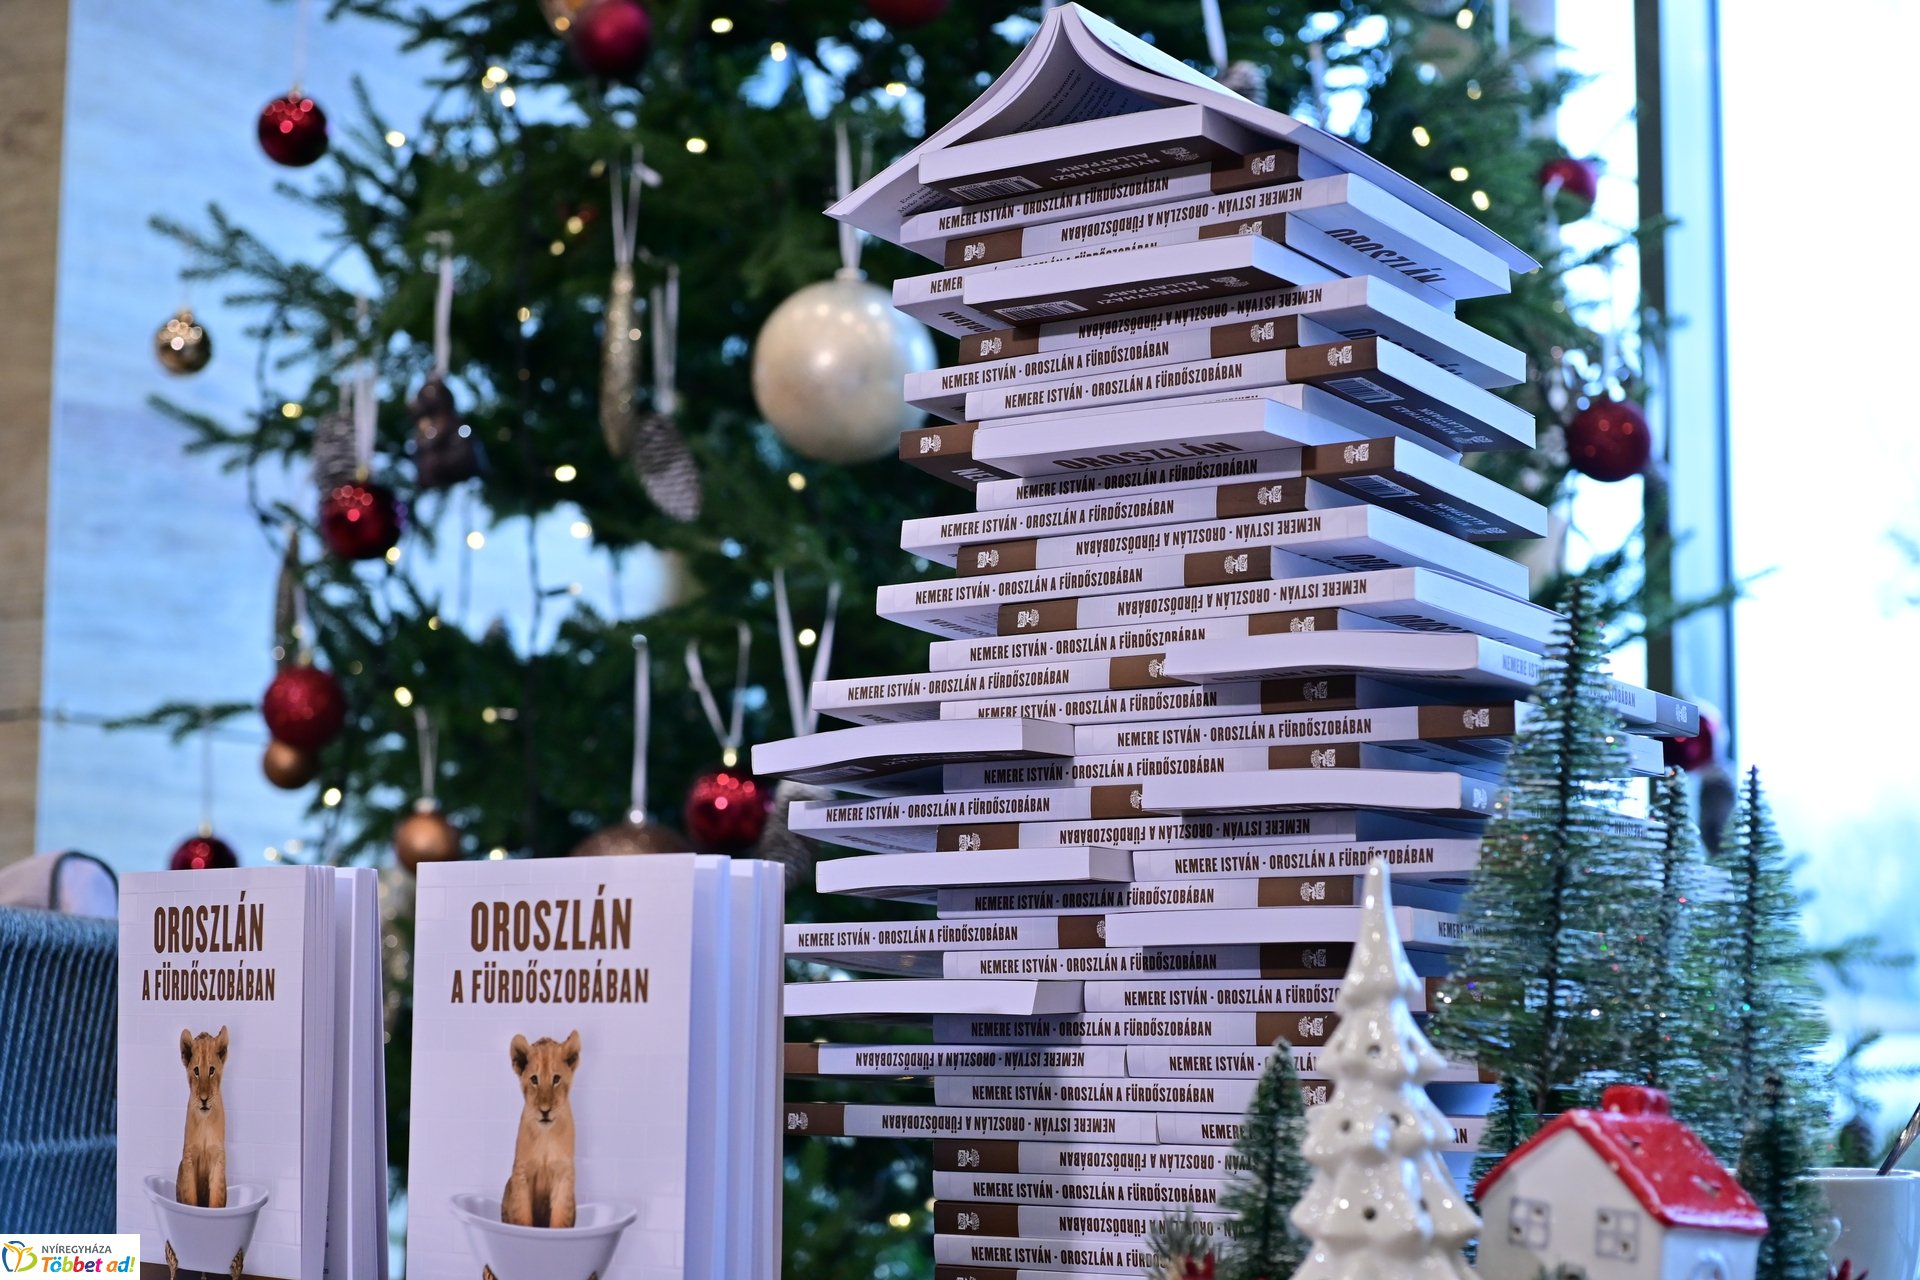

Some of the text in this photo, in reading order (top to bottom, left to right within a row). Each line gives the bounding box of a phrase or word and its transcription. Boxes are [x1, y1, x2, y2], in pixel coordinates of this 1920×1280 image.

[938, 176, 1168, 230] NEMERE ISTVÁN OROSZLÁN A FÜRDŐSZOBÁBAN
[1061, 186, 1302, 242] NEMERE ISTVÁN OROSZLÁN A FÜRDŐSZOBÁBAN
[1078, 288, 1321, 339] NEMERE ISTVÁN OROSZLÁN A FÜRDŐSZOBÁBAN
[942, 340, 1168, 390] NEMERE ISTVÁN OROSZLÁN A FÜRDŐSZOBÁBAN
[1004, 362, 1241, 409] NEMERE ISTVÁN OROSZLÁN A FÜRDŐSZOBÁBAN
[1053, 442, 1245, 470] OROSZLÁN
[1016, 457, 1257, 500] NEMERE ISTVÁN OROSZLÁN A FÜRDŐSZOBÁBAN
[940, 498, 1173, 538] NEMERE ISTVÁN OROSZLÁN A FÜRDŐSZOBÁBAN
[1076, 516, 1320, 557] NEMERE ISTVÁN OROSZLÁN A FÜRDŐSZOBÁBAN
[915, 565, 1142, 604] NEMERE ISTVÁN OROSZLÁN A FÜRDŐSZOBÁBAN
[1117, 579, 1366, 618] NEMERE ISTVÁN OROSZLÁN A FÜRDŐSZOBÁBAN
[970, 633, 1116, 661] NEMERE ISTVÁN OROSZLÁN A
[848, 667, 1068, 700] NEMERE ISTVÁN OROSZLÁN A FÜRDŐSZOBÁBAN
[1020, 690, 1216, 720] ISTVÁN OROSZLÁN A FÜRDŐSZOBÁBAN
[1117, 716, 1371, 747] NEMERE ISTVÁN OROSZLÁN A FÜRDŐSZOBÁBAN
[984, 754, 1224, 784] NEMERE ISTVÁN OROSZLÁN A FÜRDŐSZOBÁBAN
[826, 794, 1049, 822] NEMERE ISTVÁN OROSZLÁN A FÜRDŐSZOBÁBAN
[1059, 818, 1309, 848] NEMERE ISTVÁN OROSZLÁN A FÜRDŐSZOBÁBAN
[1174, 849, 1335, 873] NEMERE ISTVÁN OROSZLÁN A
[1017, 885, 1213, 909] ISTVÁN OROSZLÁN A FÜRDŐSZOBÁBAN
[153, 890, 265, 954] OROSZLÁN
[470, 884, 632, 953] OROSZLÁN
[798, 923, 1017, 947] NEMERE ISTVÁN OROSZLÁN A FÜRDŐSZOBÁBAN
[980, 951, 1216, 974] NEMERE ISTVÁN OROSZLÁN A FÜRDŐSZOBÁBAN
[142, 960, 275, 1001] A FÜRDŐSZOBÁBAN
[451, 959, 649, 1004] A FÜRDŐSZOBÁBAN
[1124, 985, 1282, 1006] NEMERE ISTVÁN OROSZLÁN A
[1058, 1017, 1211, 1036] OROSZLÁN A FÜRDŐSZOBÁBAN
[855, 1051, 1084, 1071] NEMERE ISTVÁN OROSZLÁN A FÜRDŐSZOBÁBAN
[1169, 1056, 1212, 1071] NEMERE
[1215, 1052, 1254, 1071] ISTVÁN
[972, 1082, 1213, 1103] NEMERE ISTVÁN OROSZLÁN A FÜRDŐSZOBÁBAN
[882, 1114, 1115, 1136] NEMERE ISTVÁN OROSZLÁN A FÜRDŐSZOBÁBAN
[1059, 1151, 1214, 1173] OROSZLÁN A FÜRDŐSZOBÁBAN
[973, 1179, 1216, 1203] NEMERE ISTVÁN OROSZLÁN A FÜRDŐSZOBÁBAN
[1059, 1216, 1146, 1237] FÜRDŐSZOBÁBAN
[971, 1246, 1012, 1262] NEMERE
[1014, 1245, 1051, 1264] ISTVÁN
[1060, 1248, 1113, 1266] OROSZLÁN
[1116, 1252, 1122, 1267] A
